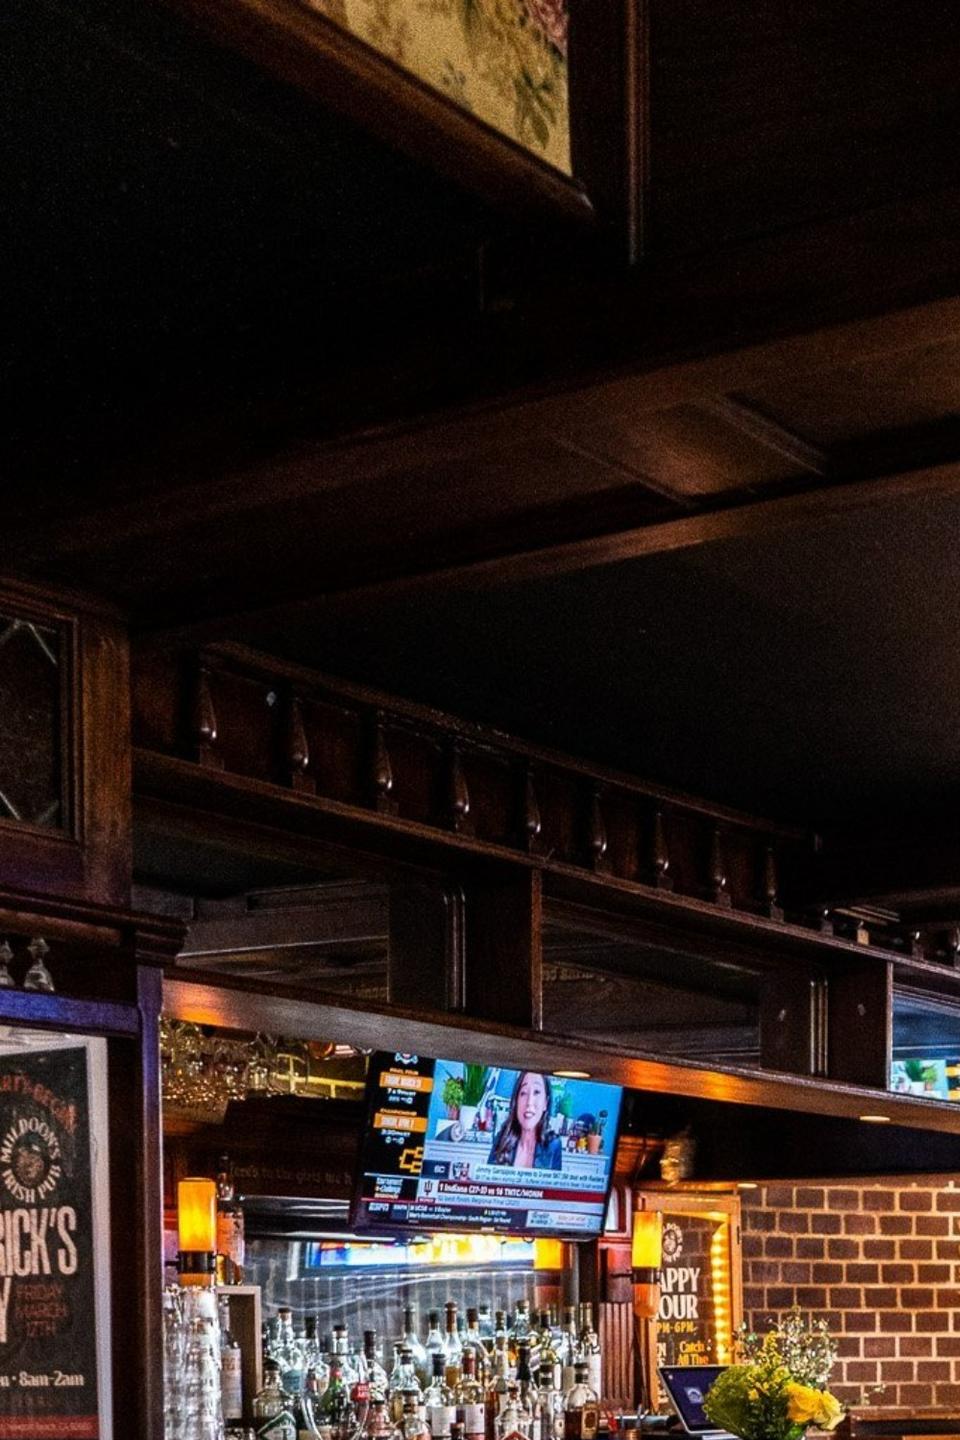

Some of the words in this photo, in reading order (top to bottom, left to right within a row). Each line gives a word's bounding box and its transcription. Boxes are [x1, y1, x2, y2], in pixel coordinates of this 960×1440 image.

[2, 1168, 36, 1203] IRISH
[37, 1164, 61, 1199] PUB
[439, 1183, 444, 1192] 1
[445, 1183, 468, 1194] Indiana
[660, 1267, 701, 1293] APPY
[16, 1284, 63, 1299] FRIDAY
[658, 1294, 699, 1320] OUR
[678, 1353, 690, 1366] All
[690, 1353, 710, 1366] The
[18, 1370, 85, 1387] 8am-2am
